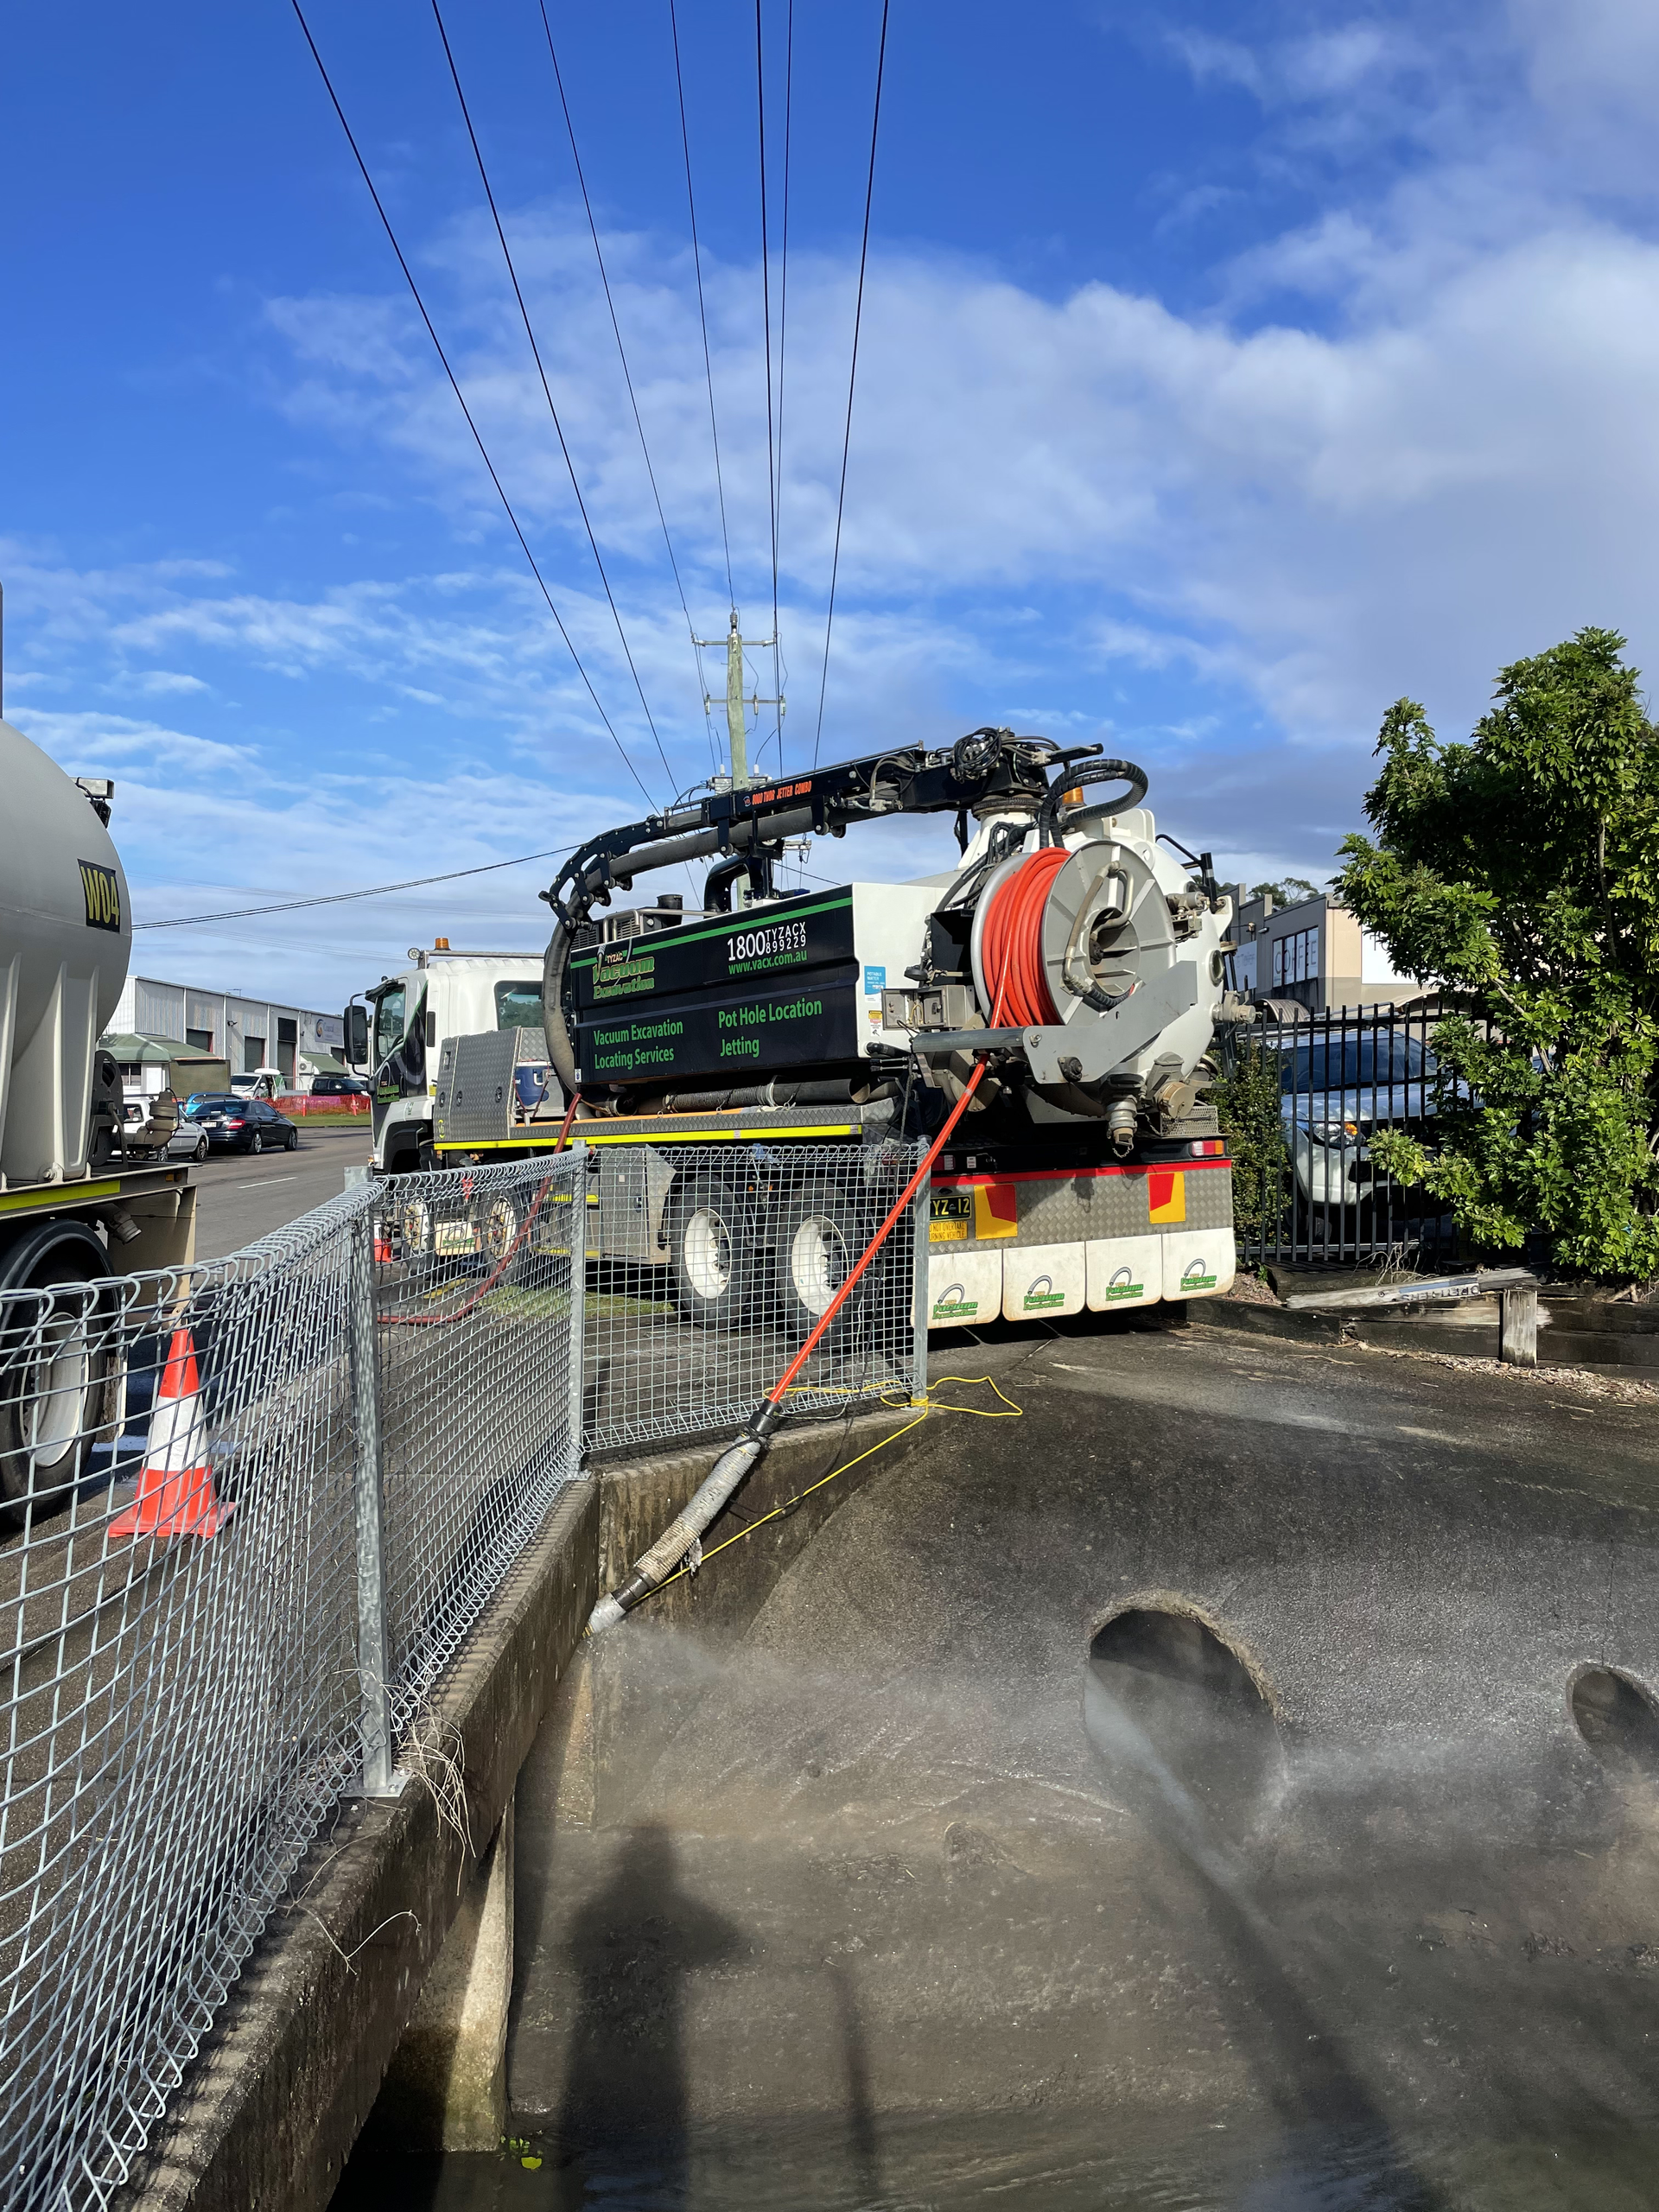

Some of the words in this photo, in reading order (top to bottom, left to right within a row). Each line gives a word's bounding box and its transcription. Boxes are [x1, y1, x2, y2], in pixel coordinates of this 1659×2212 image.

[777, 785, 793, 799] JETTER
[795, 780, 811, 795] COMBO
[80, 866, 119, 925] W04
[728, 931, 766, 961] 1800
[765, 921, 806, 942] TYZACX
[766, 935, 806, 954] 899229
[593, 957, 655, 985] Vacuum
[728, 950, 808, 975] www.vacx.com.au
[594, 976, 655, 1000] Excavation
[718, 1010, 737, 1028] Pot
[739, 1004, 766, 1026] Hole
[768, 997, 823, 1021] Location
[594, 1028, 629, 1046] Vacuum
[631, 1018, 683, 1040] Excavation
[594, 1050, 632, 1071] Locating
[634, 1046, 674, 1065] Services
[720, 1036, 760, 1058] Jetting
[930, 1199, 949, 1216] YZ
[929, 1231, 945, 1241] URNING
